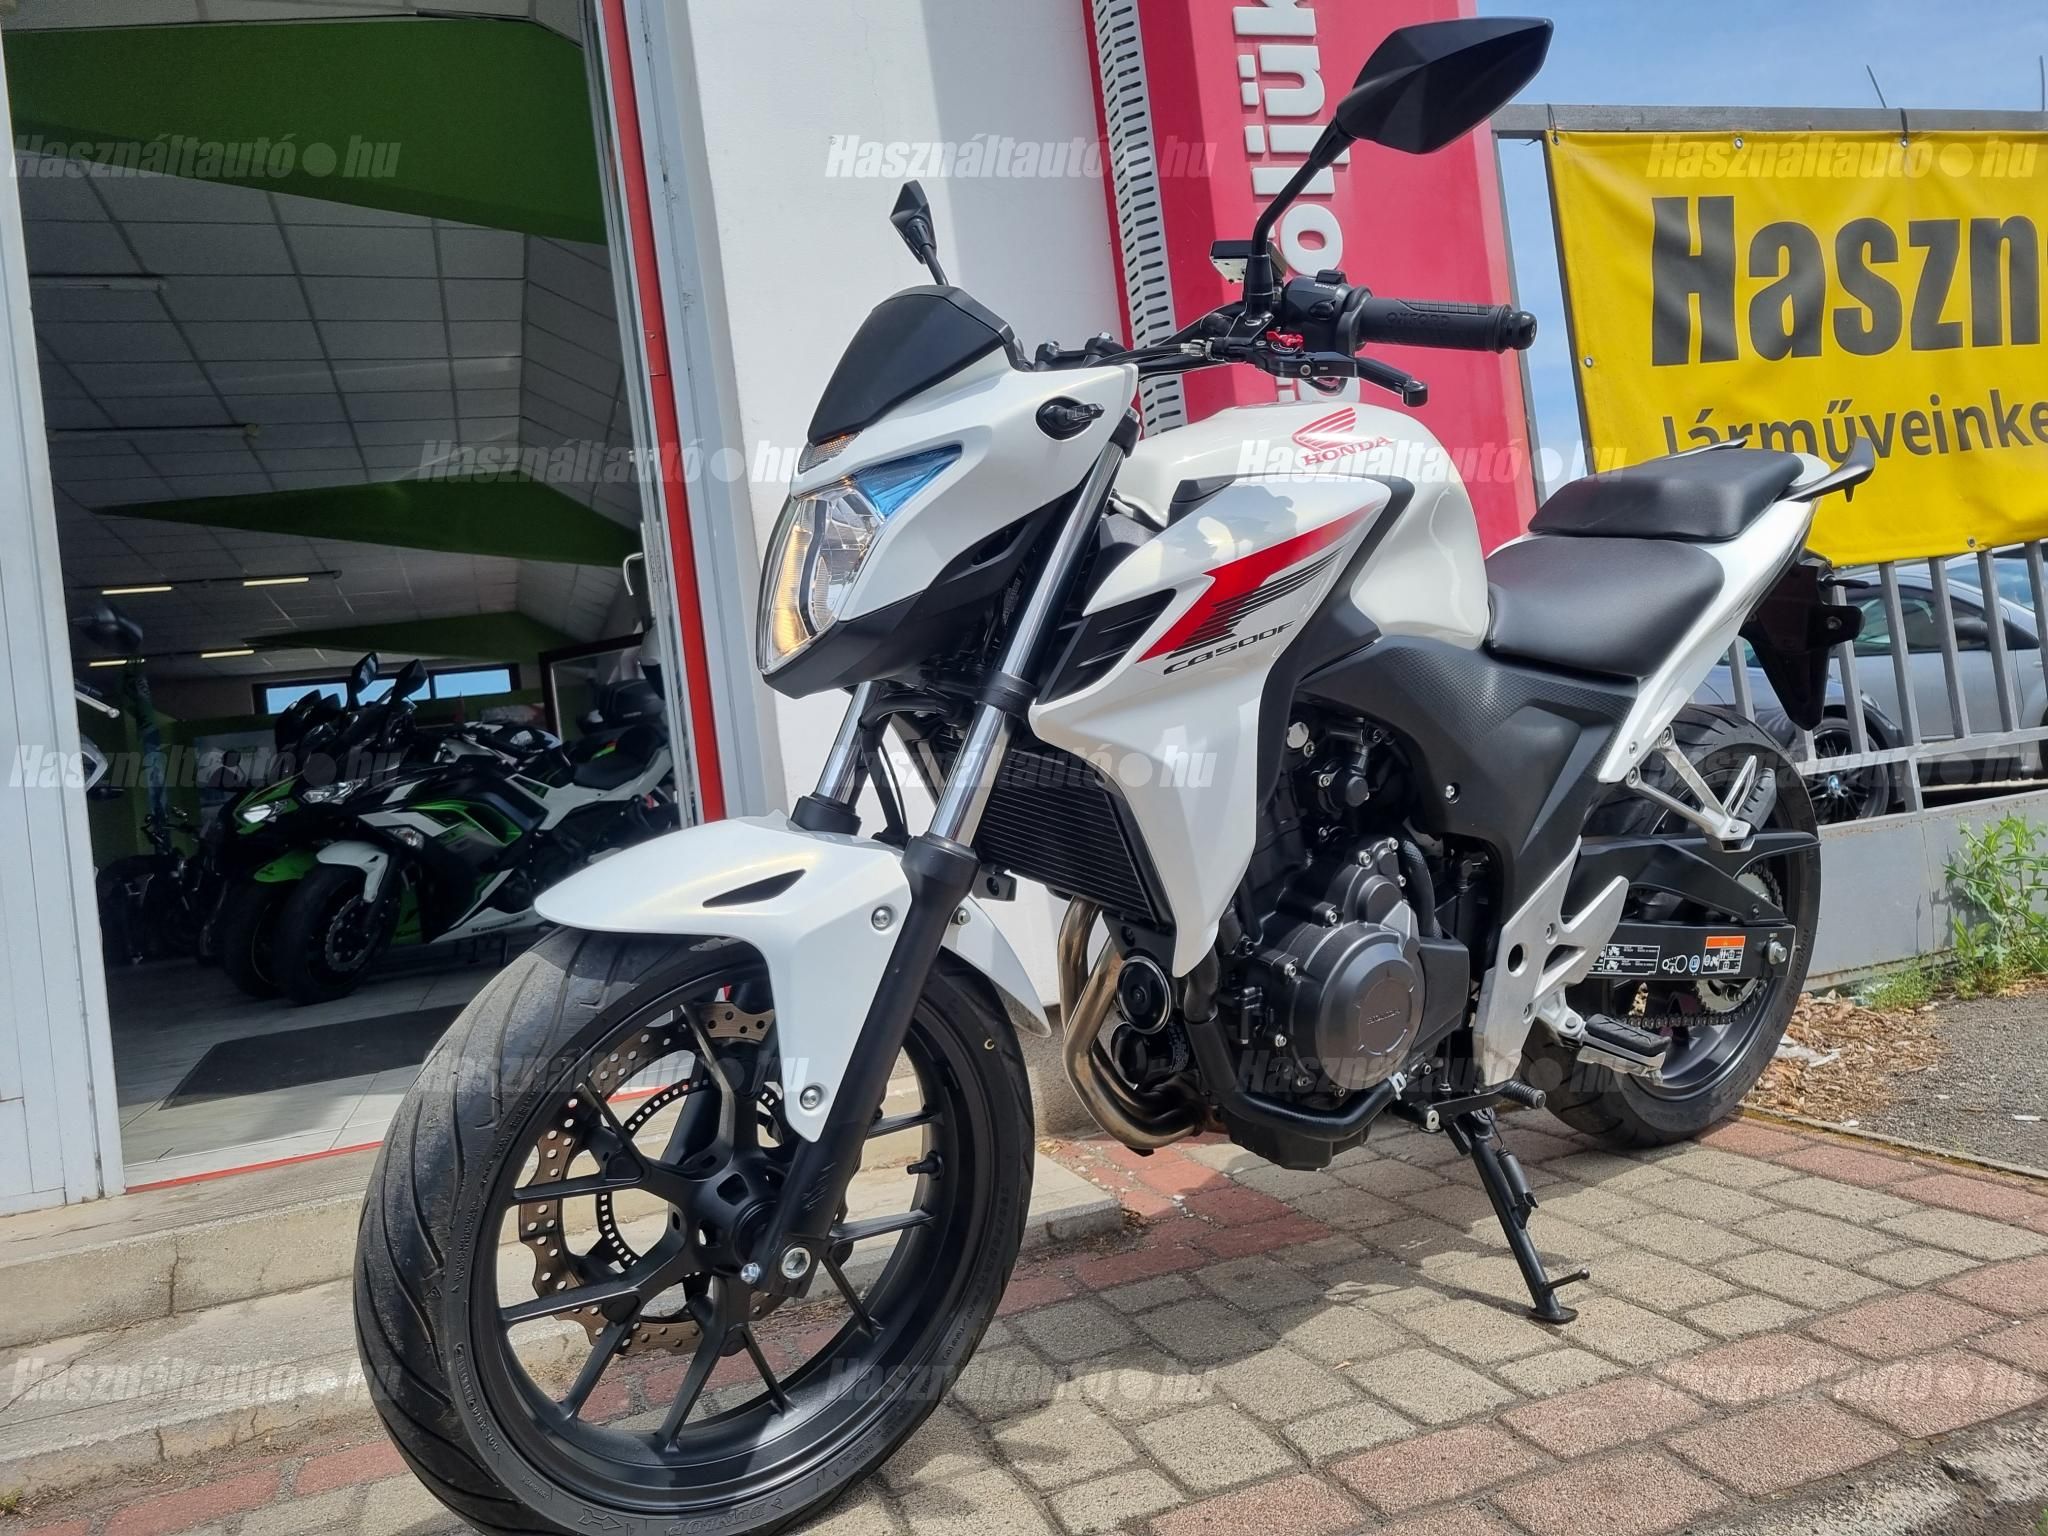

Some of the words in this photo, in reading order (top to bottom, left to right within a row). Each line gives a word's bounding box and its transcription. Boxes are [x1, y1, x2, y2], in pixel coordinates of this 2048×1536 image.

[1651, 195, 2048, 366] Haszn
[1385, 311, 1450, 327] OXFORD
[1302, 436, 1393, 466] HONDA
[1164, 620, 1296, 675] CB500F
